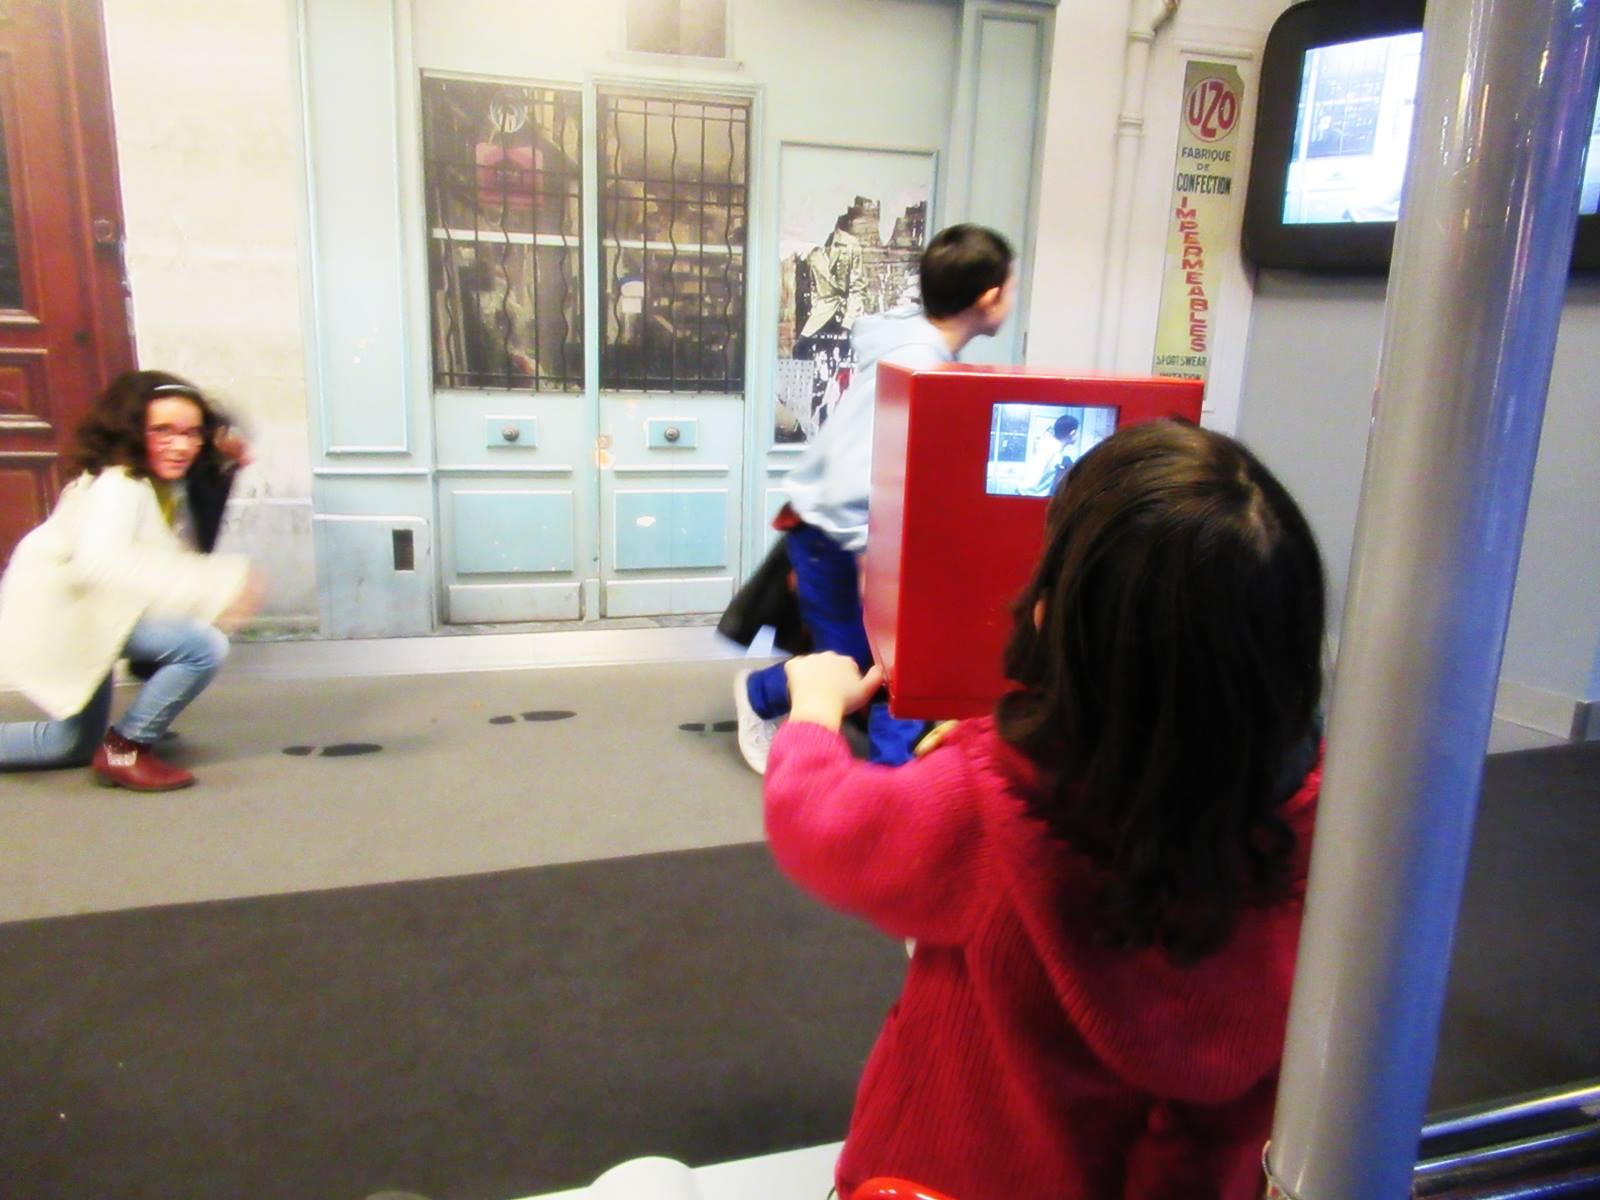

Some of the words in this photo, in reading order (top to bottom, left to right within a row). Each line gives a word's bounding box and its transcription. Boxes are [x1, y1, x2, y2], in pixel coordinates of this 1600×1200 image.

[1189, 80, 1236, 138] UZO
[1182, 147, 1231, 162] FABRIQUE
[1196, 163, 1209, 171] DE
[1176, 173, 1231, 195] CONFECTION
[1176, 197, 1208, 352] IMPERMEABLES
[1155, 354, 1207, 367] SPORTSWEAR
